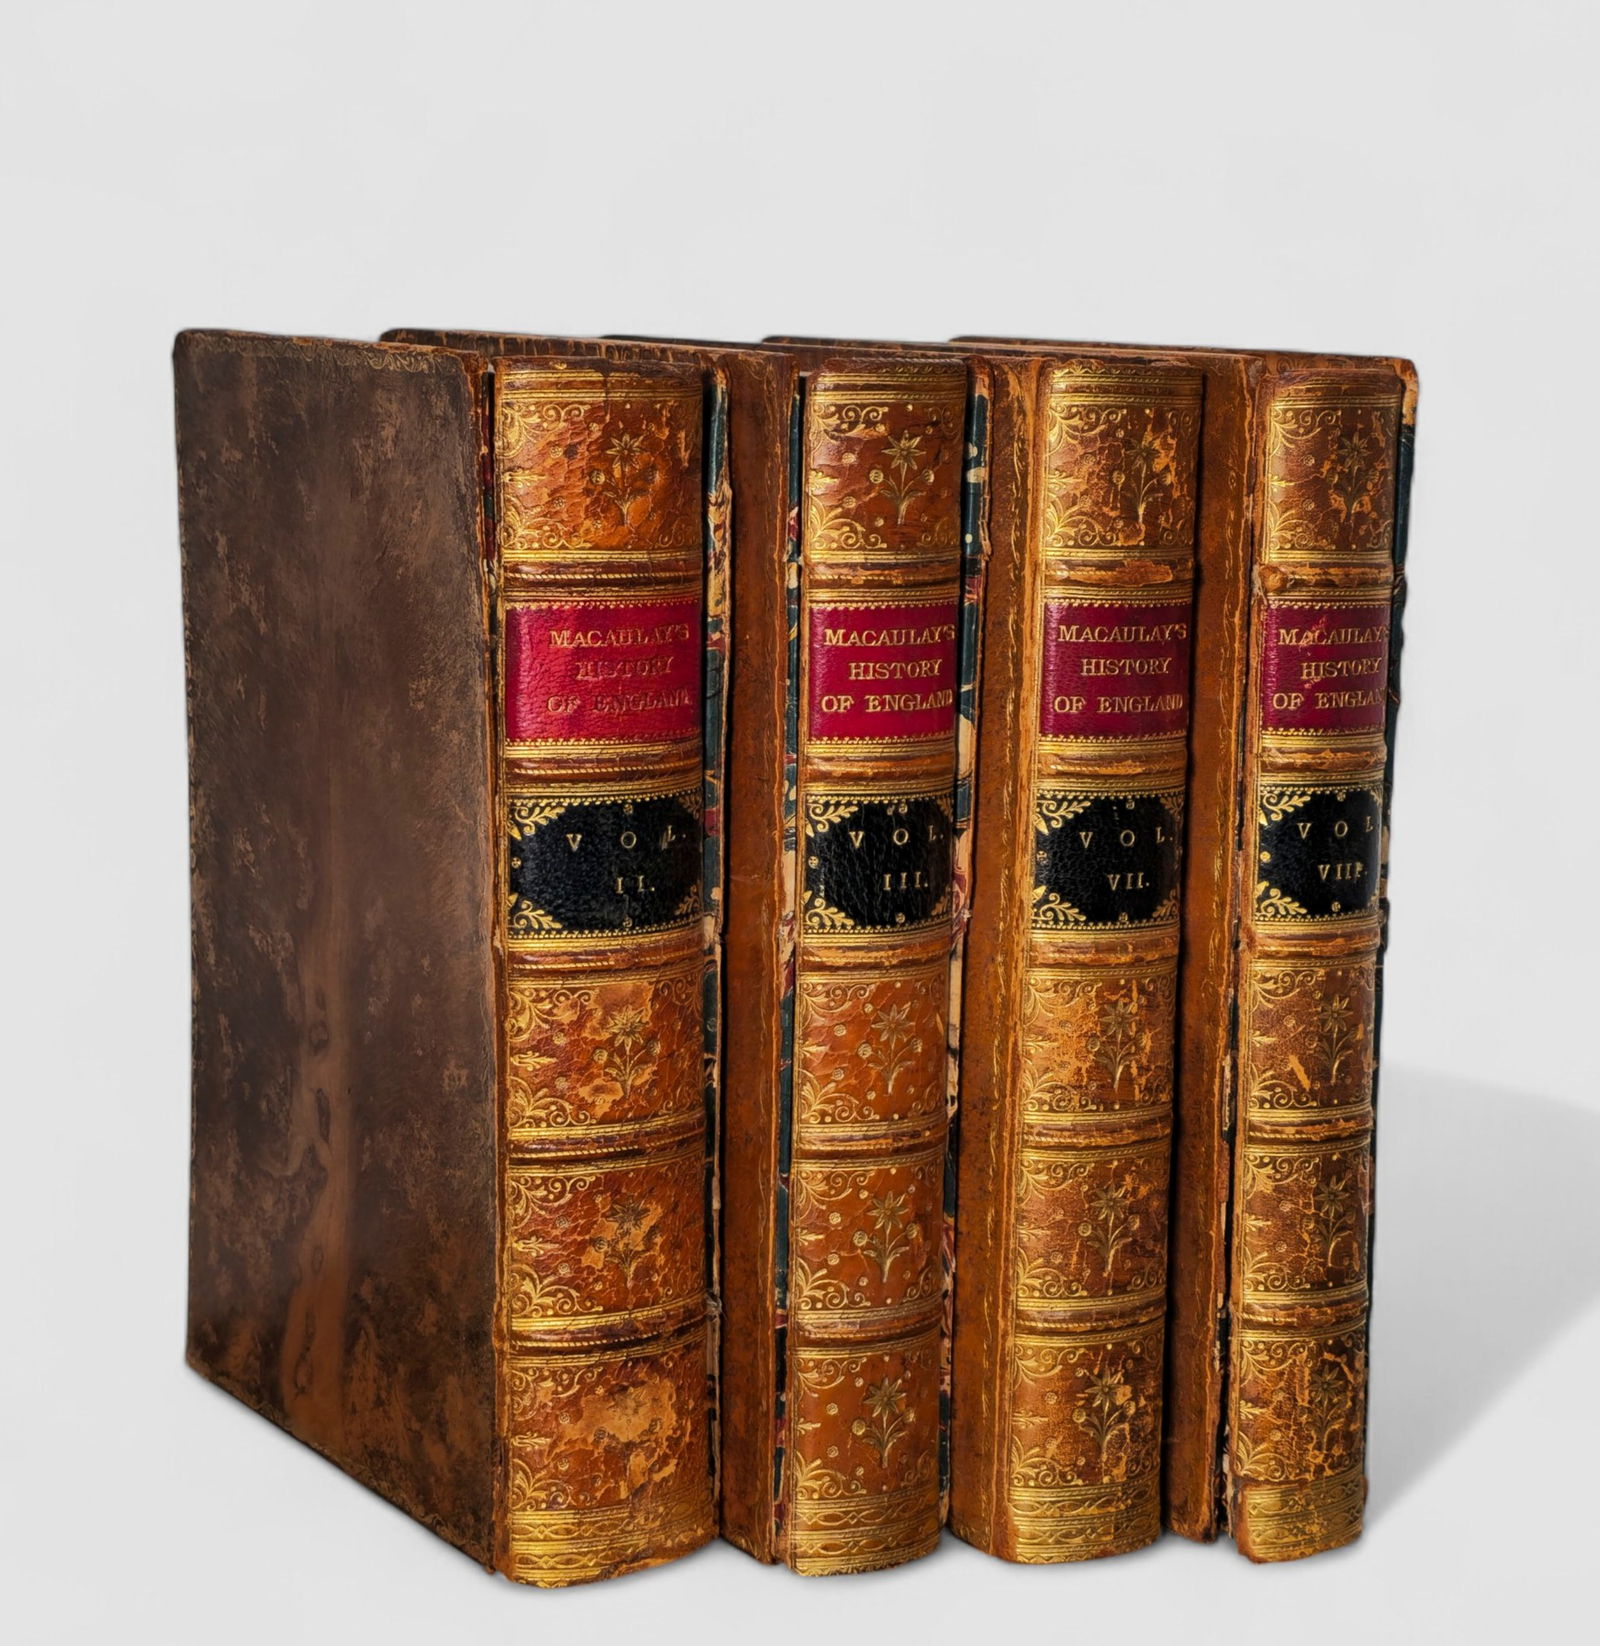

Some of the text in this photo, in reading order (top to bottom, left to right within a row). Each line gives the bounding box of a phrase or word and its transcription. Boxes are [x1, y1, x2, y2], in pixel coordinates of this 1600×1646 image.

[822, 624, 956, 647] MACAULAY'S
[1057, 623, 1187, 643] MACAULAY'S
[848, 659, 943, 680] HISTORY
[1080, 657, 1172, 676] HISTORY
[1300, 657, 1382, 680] HISTORY
[547, 695, 582, 713] OF
[821, 689, 954, 713] OF ENGLAND
[1053, 693, 1184, 714] OF ENGLAND
[1272, 692, 1305, 711] OF
[883, 871, 928, 891] III.
[1106, 872, 1149, 891] VII.
